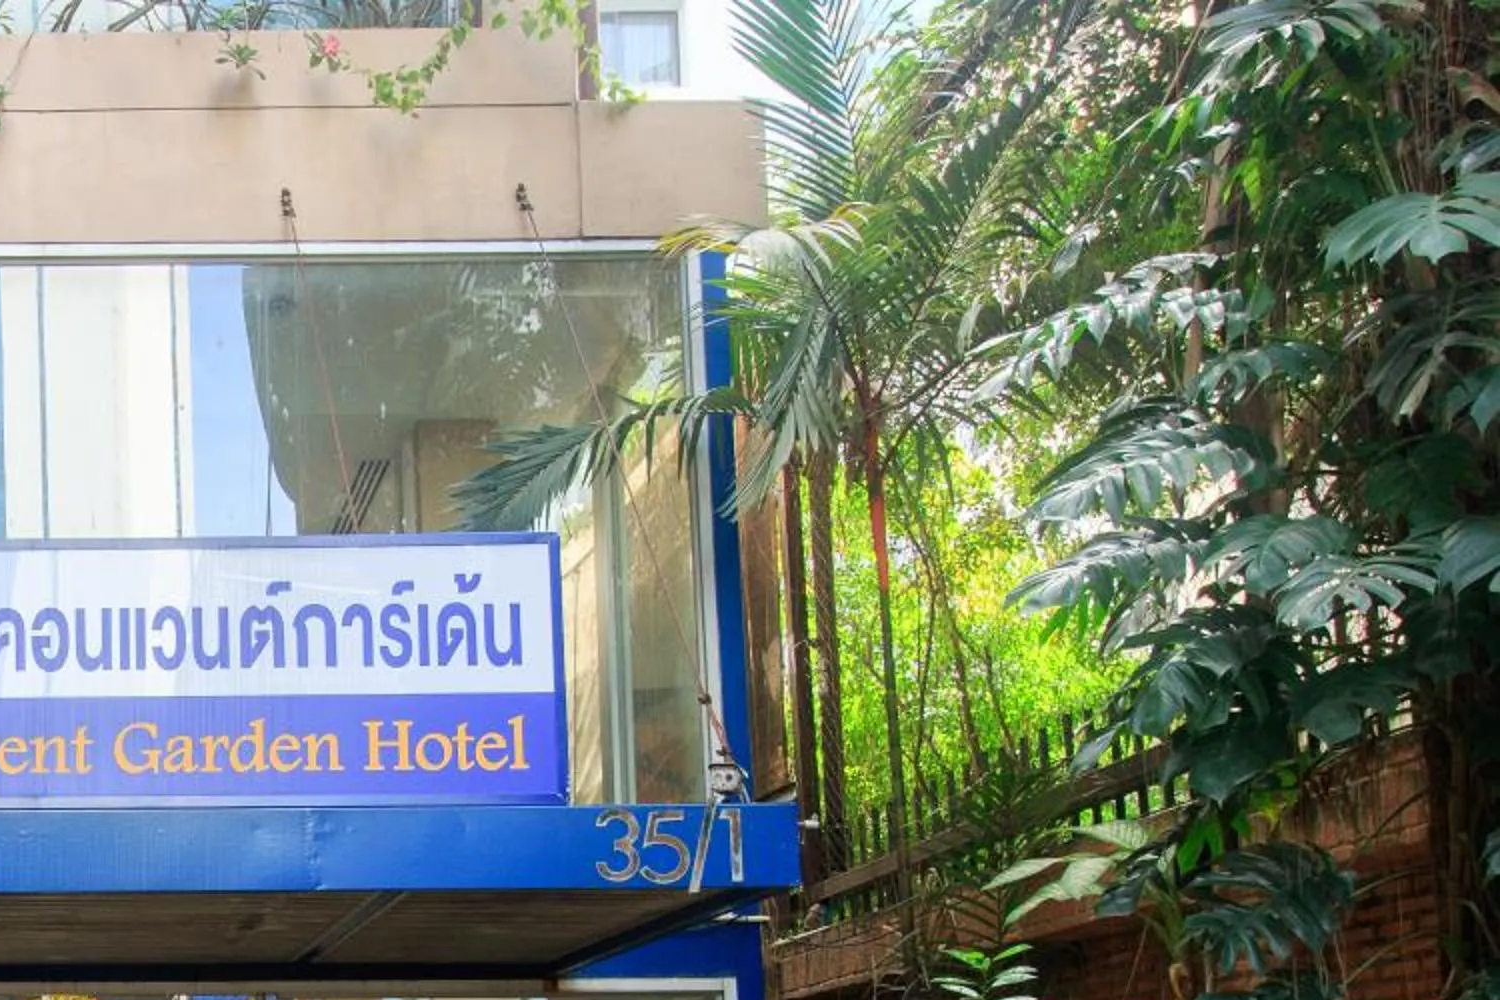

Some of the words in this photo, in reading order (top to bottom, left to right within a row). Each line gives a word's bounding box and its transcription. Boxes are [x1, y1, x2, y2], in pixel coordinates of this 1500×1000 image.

[113, 718, 345, 775] Garden
[362, 715, 530, 771] Hotel
[595, 806, 745, 894] 35/1
